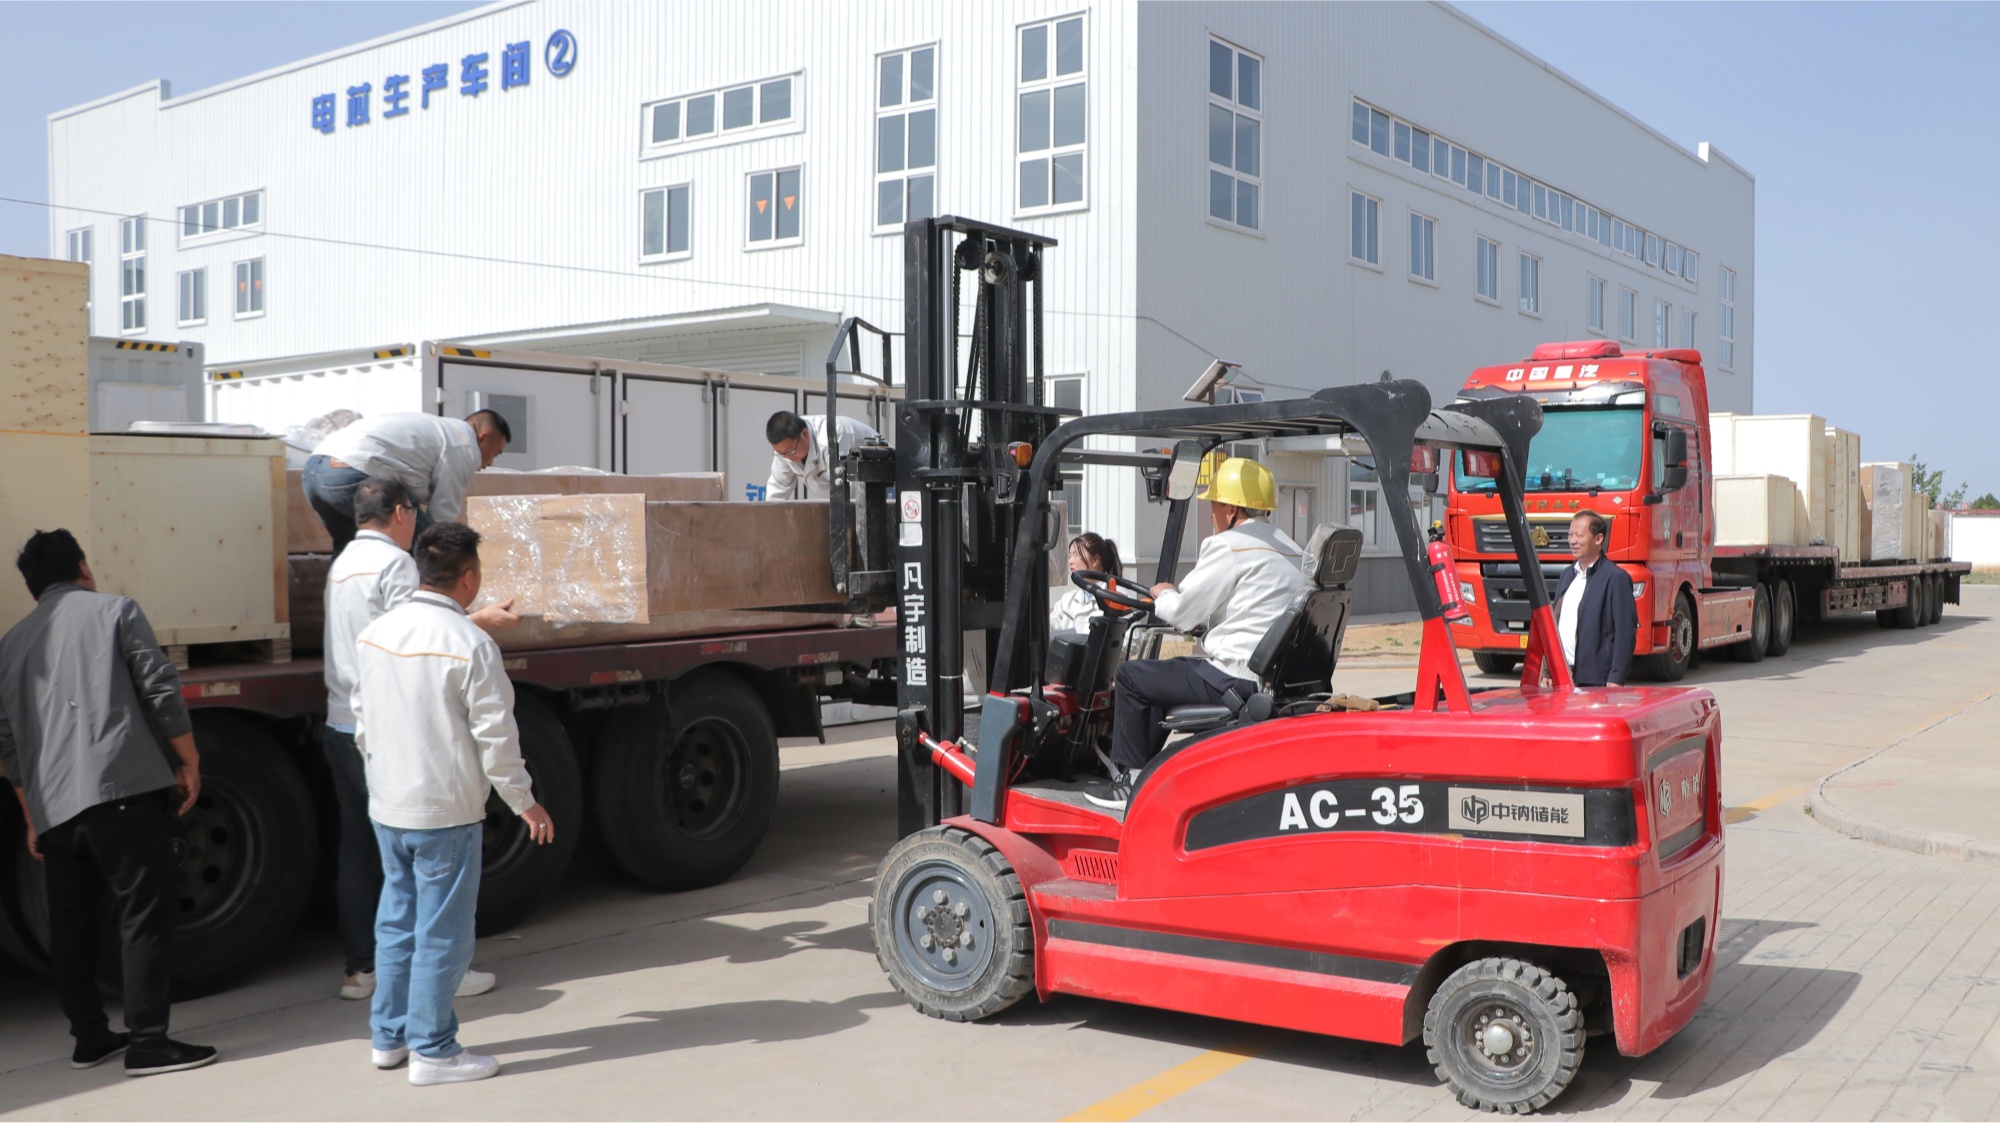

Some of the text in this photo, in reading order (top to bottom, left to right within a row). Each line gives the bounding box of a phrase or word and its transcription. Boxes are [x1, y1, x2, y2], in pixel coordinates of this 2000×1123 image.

[1523, 499, 1581, 510] TRAK
[903, 561, 928, 687] 凡宇制造
[1279, 784, 1425, 831] AC-35
[1491, 802, 1570, 824] 中钠储能
